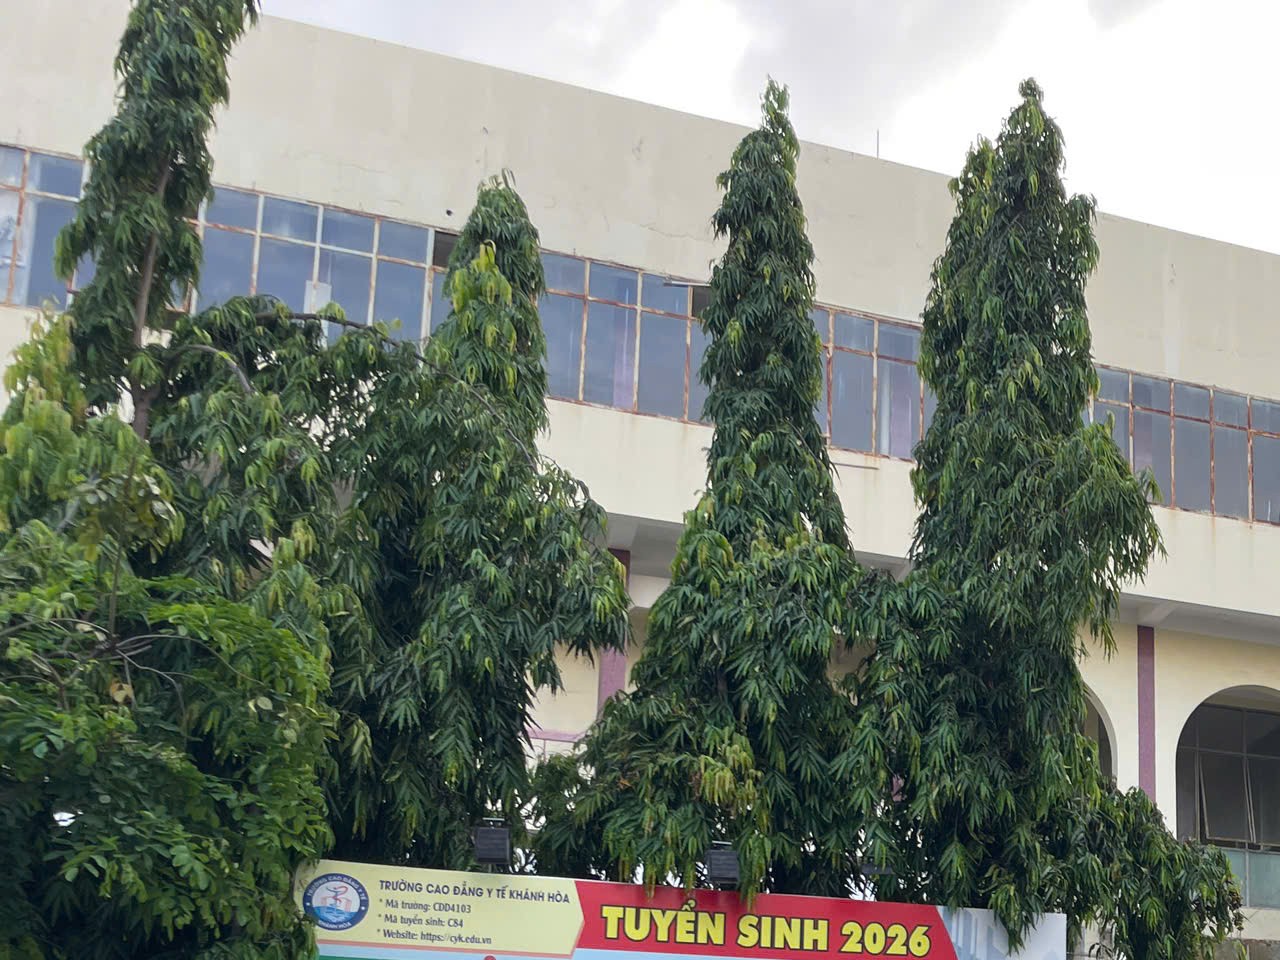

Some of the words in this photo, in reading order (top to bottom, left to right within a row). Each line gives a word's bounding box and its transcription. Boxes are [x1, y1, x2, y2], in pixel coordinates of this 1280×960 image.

[380, 878, 422, 892] TRƯỜNG
[426, 884, 450, 895] CAO
[453, 880, 484, 898] ĐẲNG
[486, 888, 493, 898] Y
[496, 885, 508, 899] TẾ
[509, 889, 545, 902] KHÁNH
[548, 893, 570, 904] HÒA
[383, 928, 418, 941] Website:
[602, 900, 726, 945] TUYỂN
[737, 914, 829, 951] SINH
[840, 921, 932, 957] 2026
